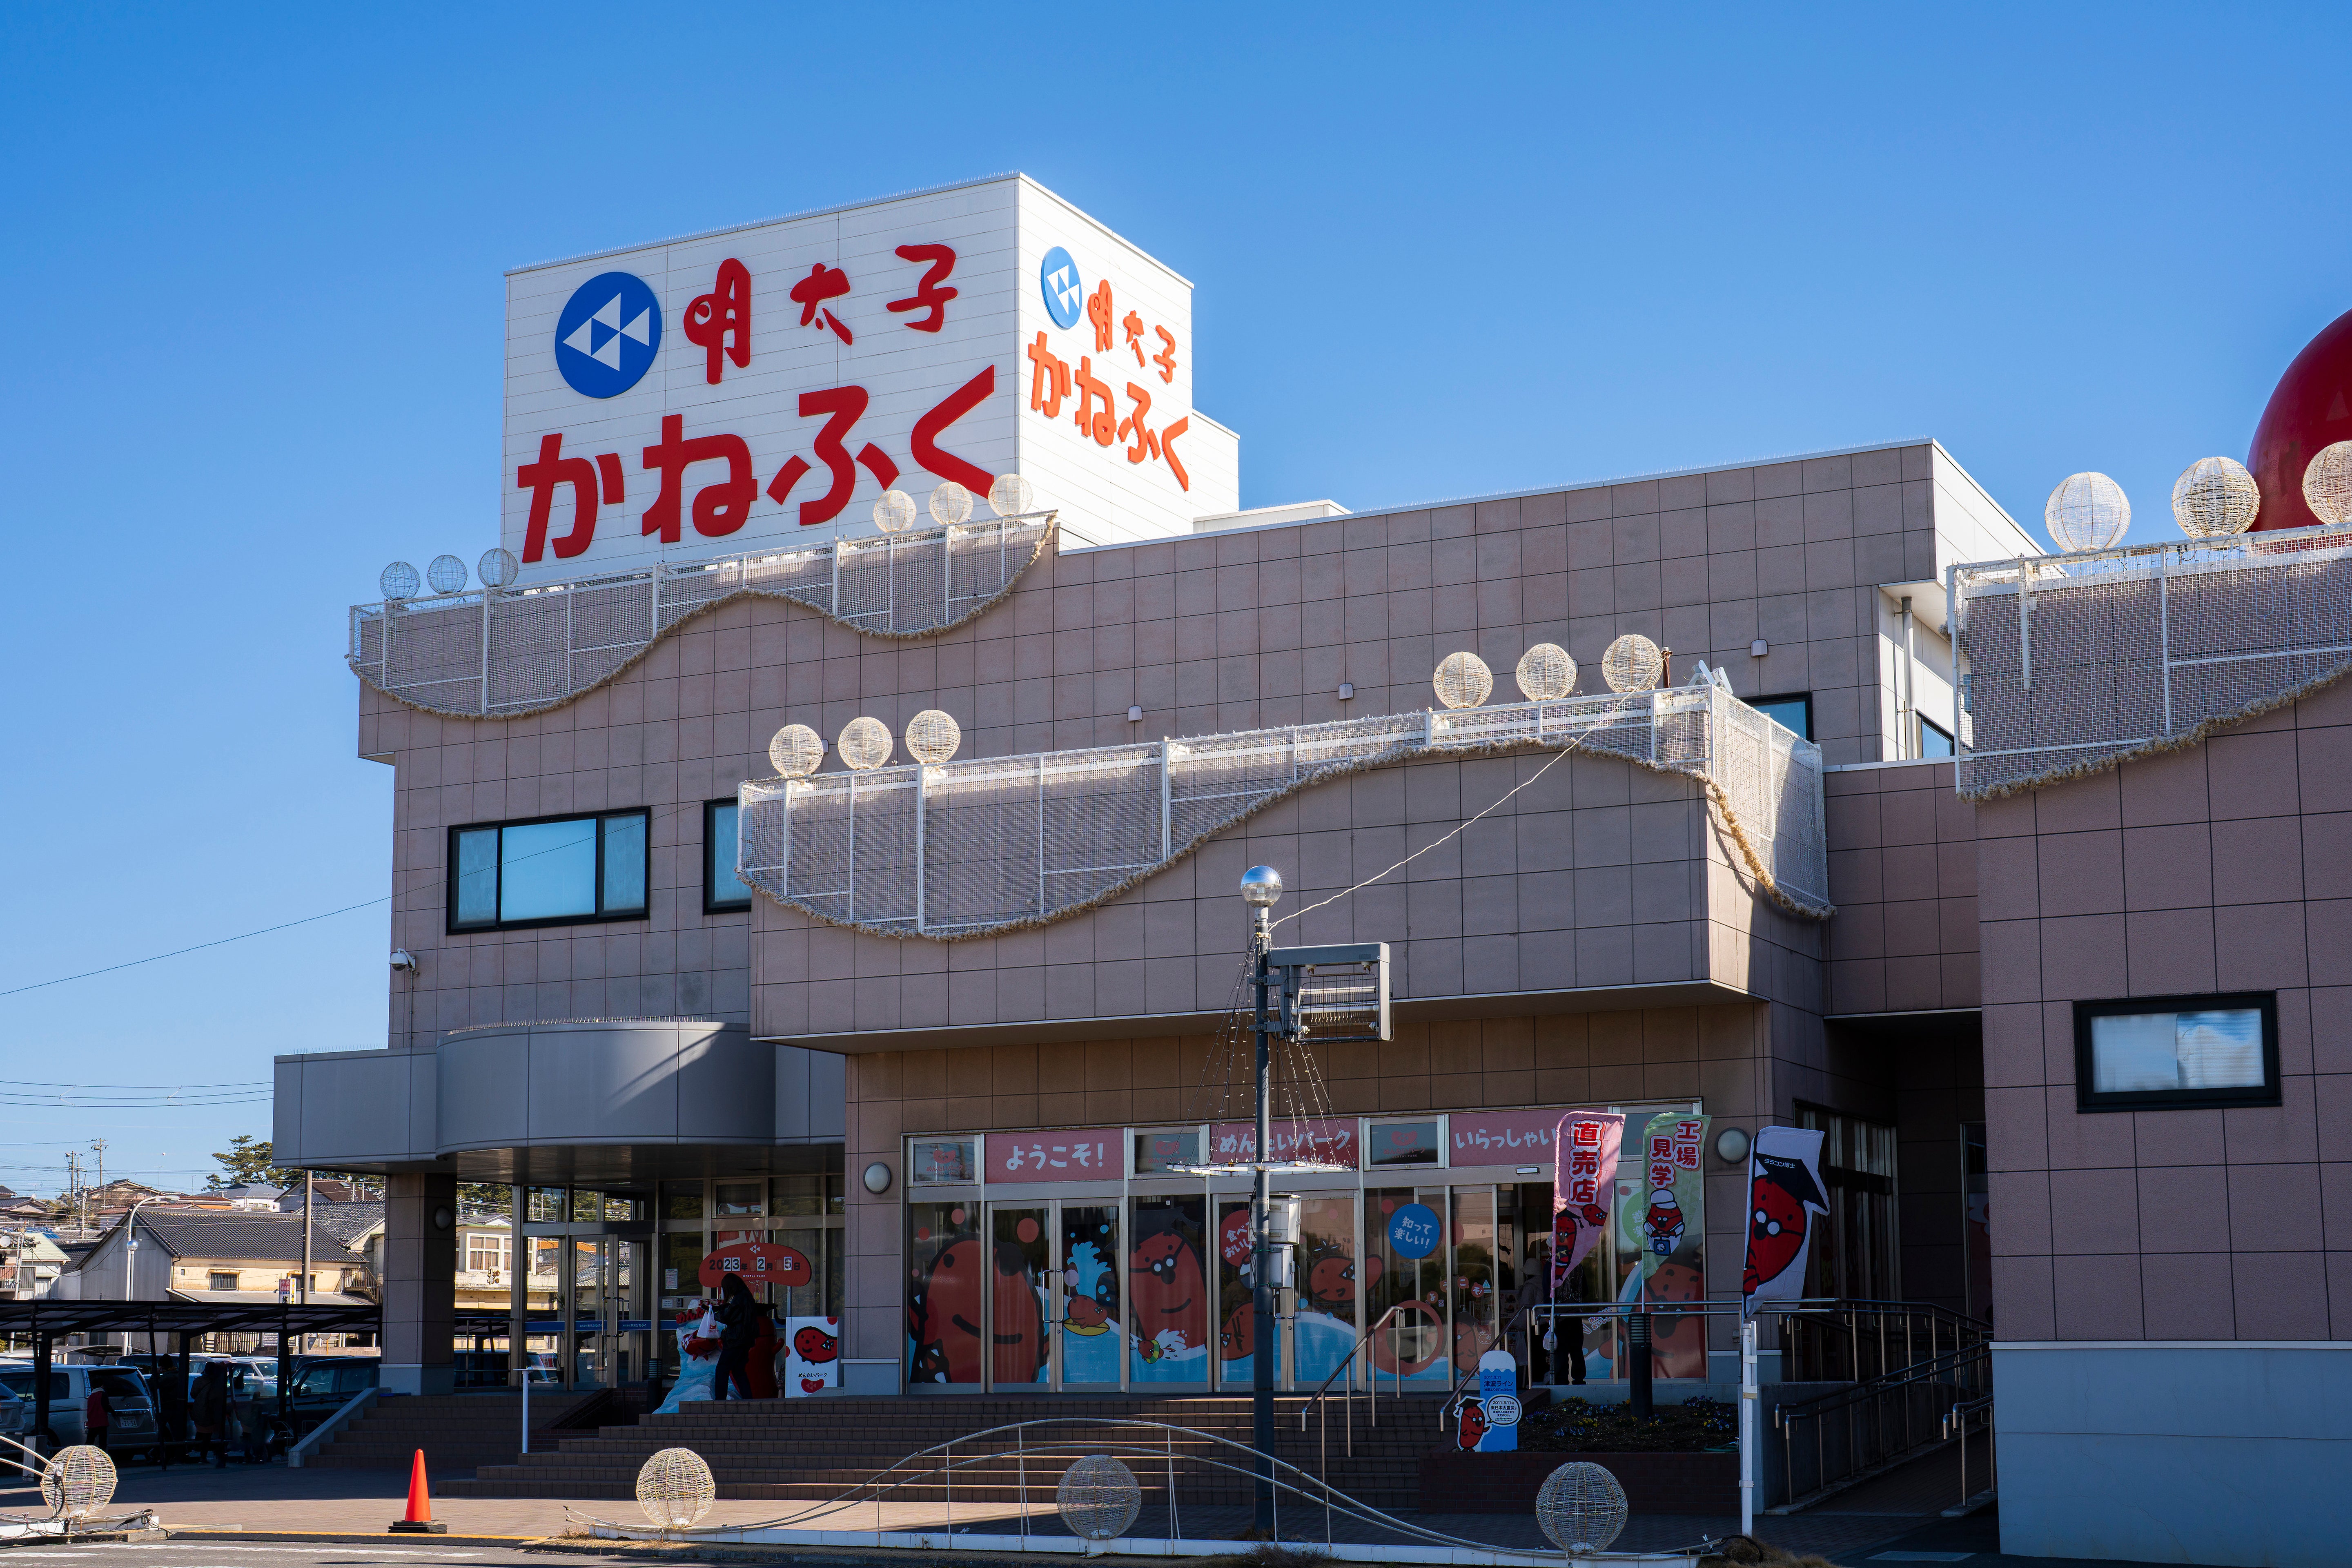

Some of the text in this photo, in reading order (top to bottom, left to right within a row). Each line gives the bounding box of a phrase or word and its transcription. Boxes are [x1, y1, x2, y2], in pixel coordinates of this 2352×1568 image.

[684, 244, 959, 385] 明太子
[1087, 279, 1176, 384] 明太子
[1028, 331, 1189, 492] かねふく
[517, 364, 995, 564] かねふく
[1006, 1143, 1104, 1171] ようこそ!
[1383, 1146, 1426, 1155] めんたいパーク
[1571, 1122, 1601, 1204] 直売店
[1651, 1138, 1672, 1185] 見学
[1676, 1123, 1699, 1166] 工場
[1394, 1227, 1430, 1249] 楽しい!
[1402, 1215, 1432, 1235] 知って
[709, 1258, 748, 1271] 2023年
[757, 1258, 773, 1271] 2月
